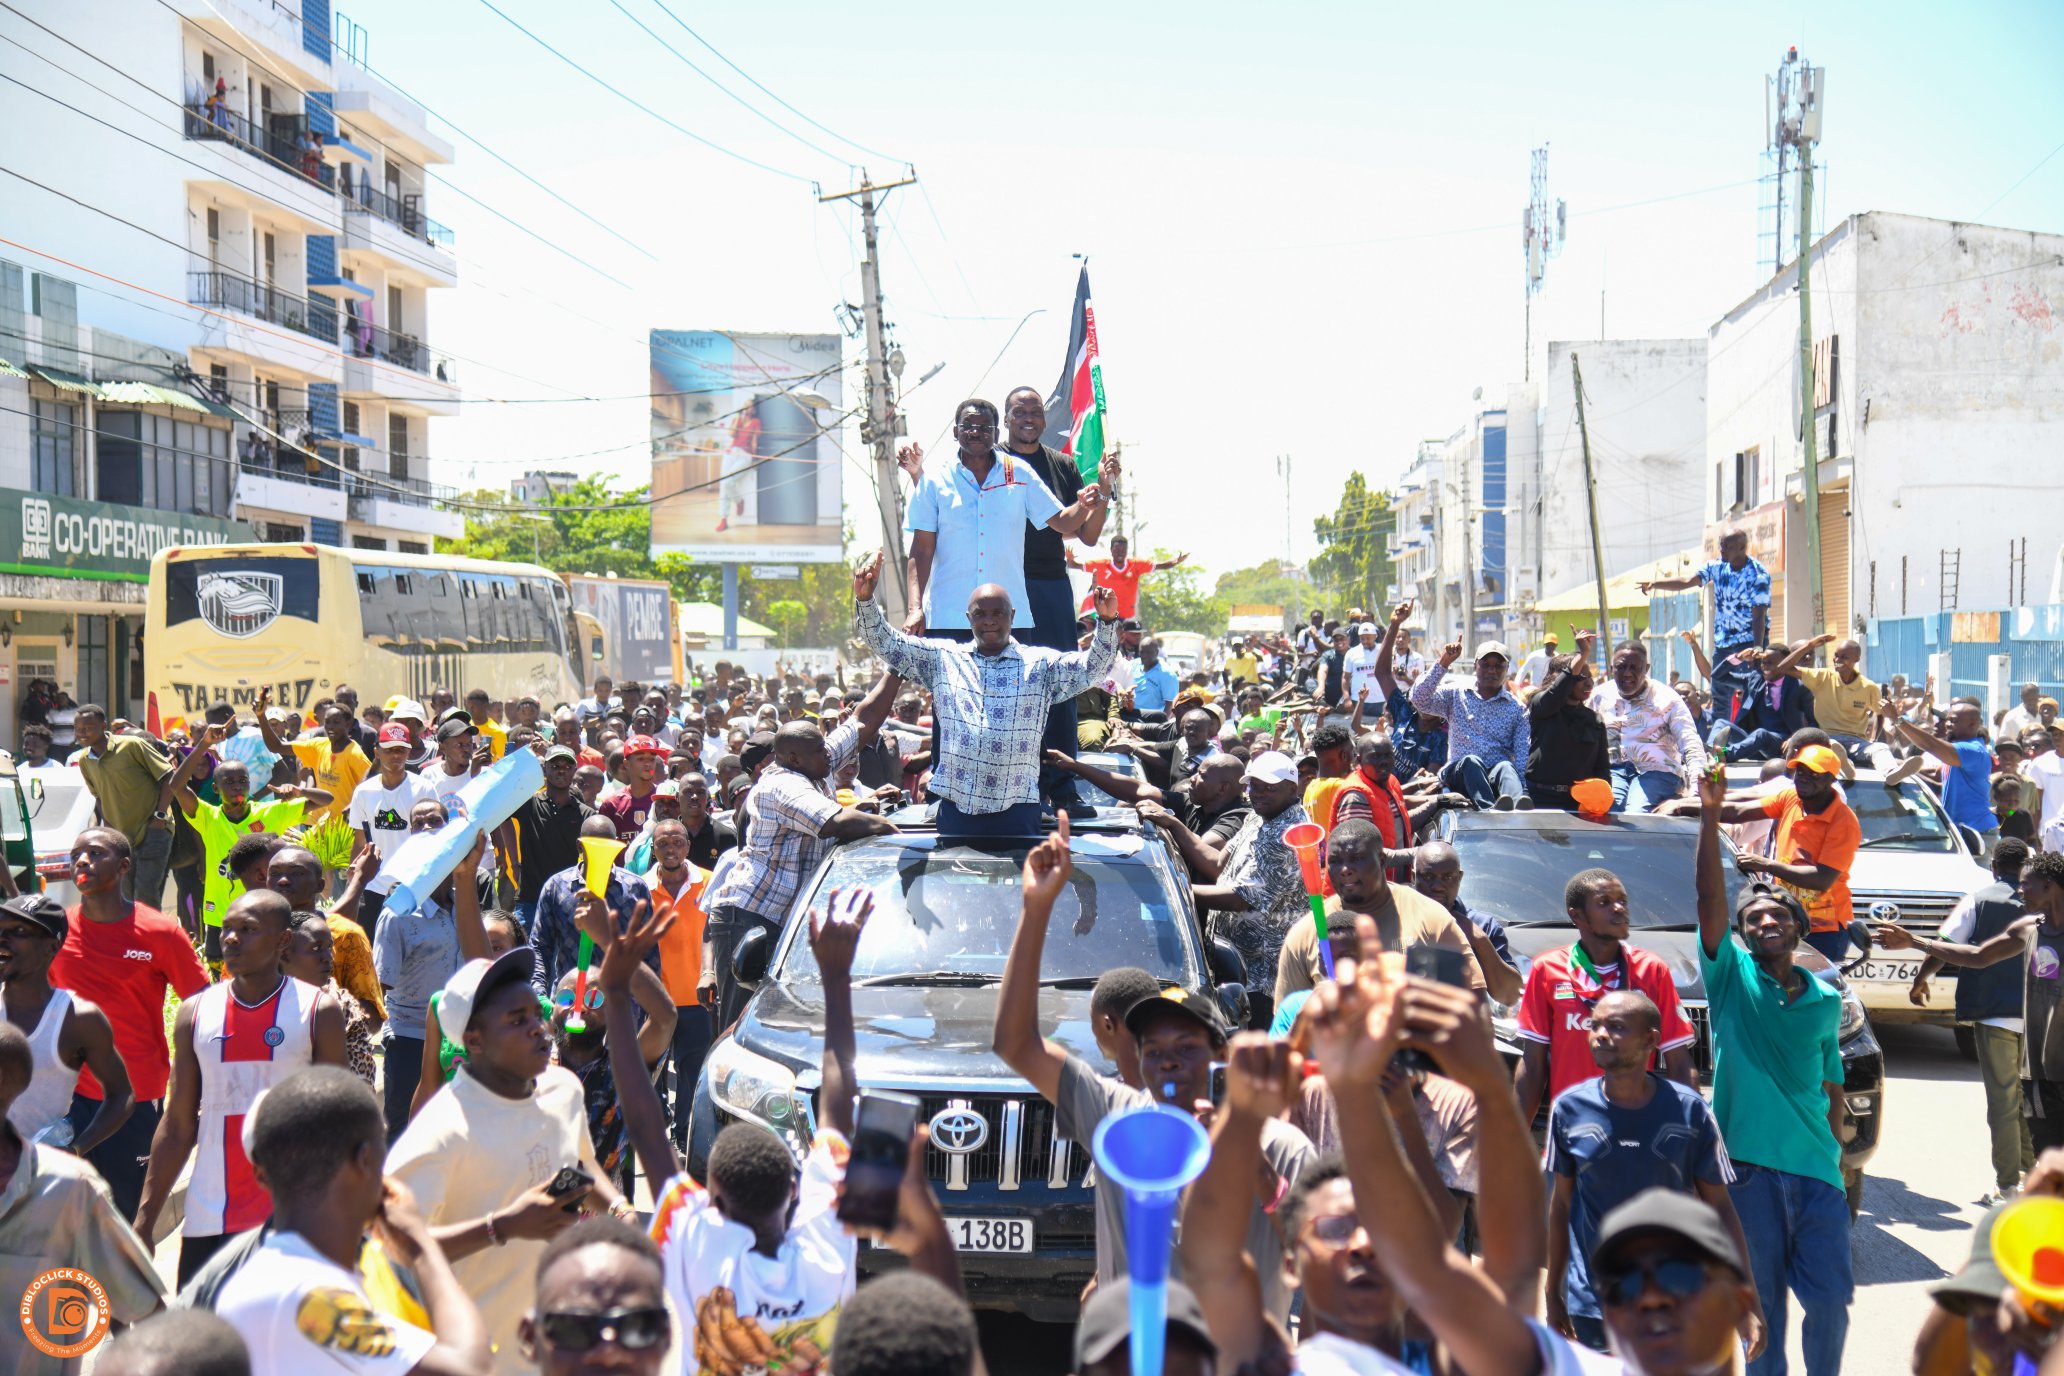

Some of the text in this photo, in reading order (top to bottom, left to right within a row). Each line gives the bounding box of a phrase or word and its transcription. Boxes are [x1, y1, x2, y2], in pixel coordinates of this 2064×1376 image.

[22, 541, 50, 559] BANK
[625, 591, 664, 641] PEMBE
[958, 1219, 1025, 1251] 138B
